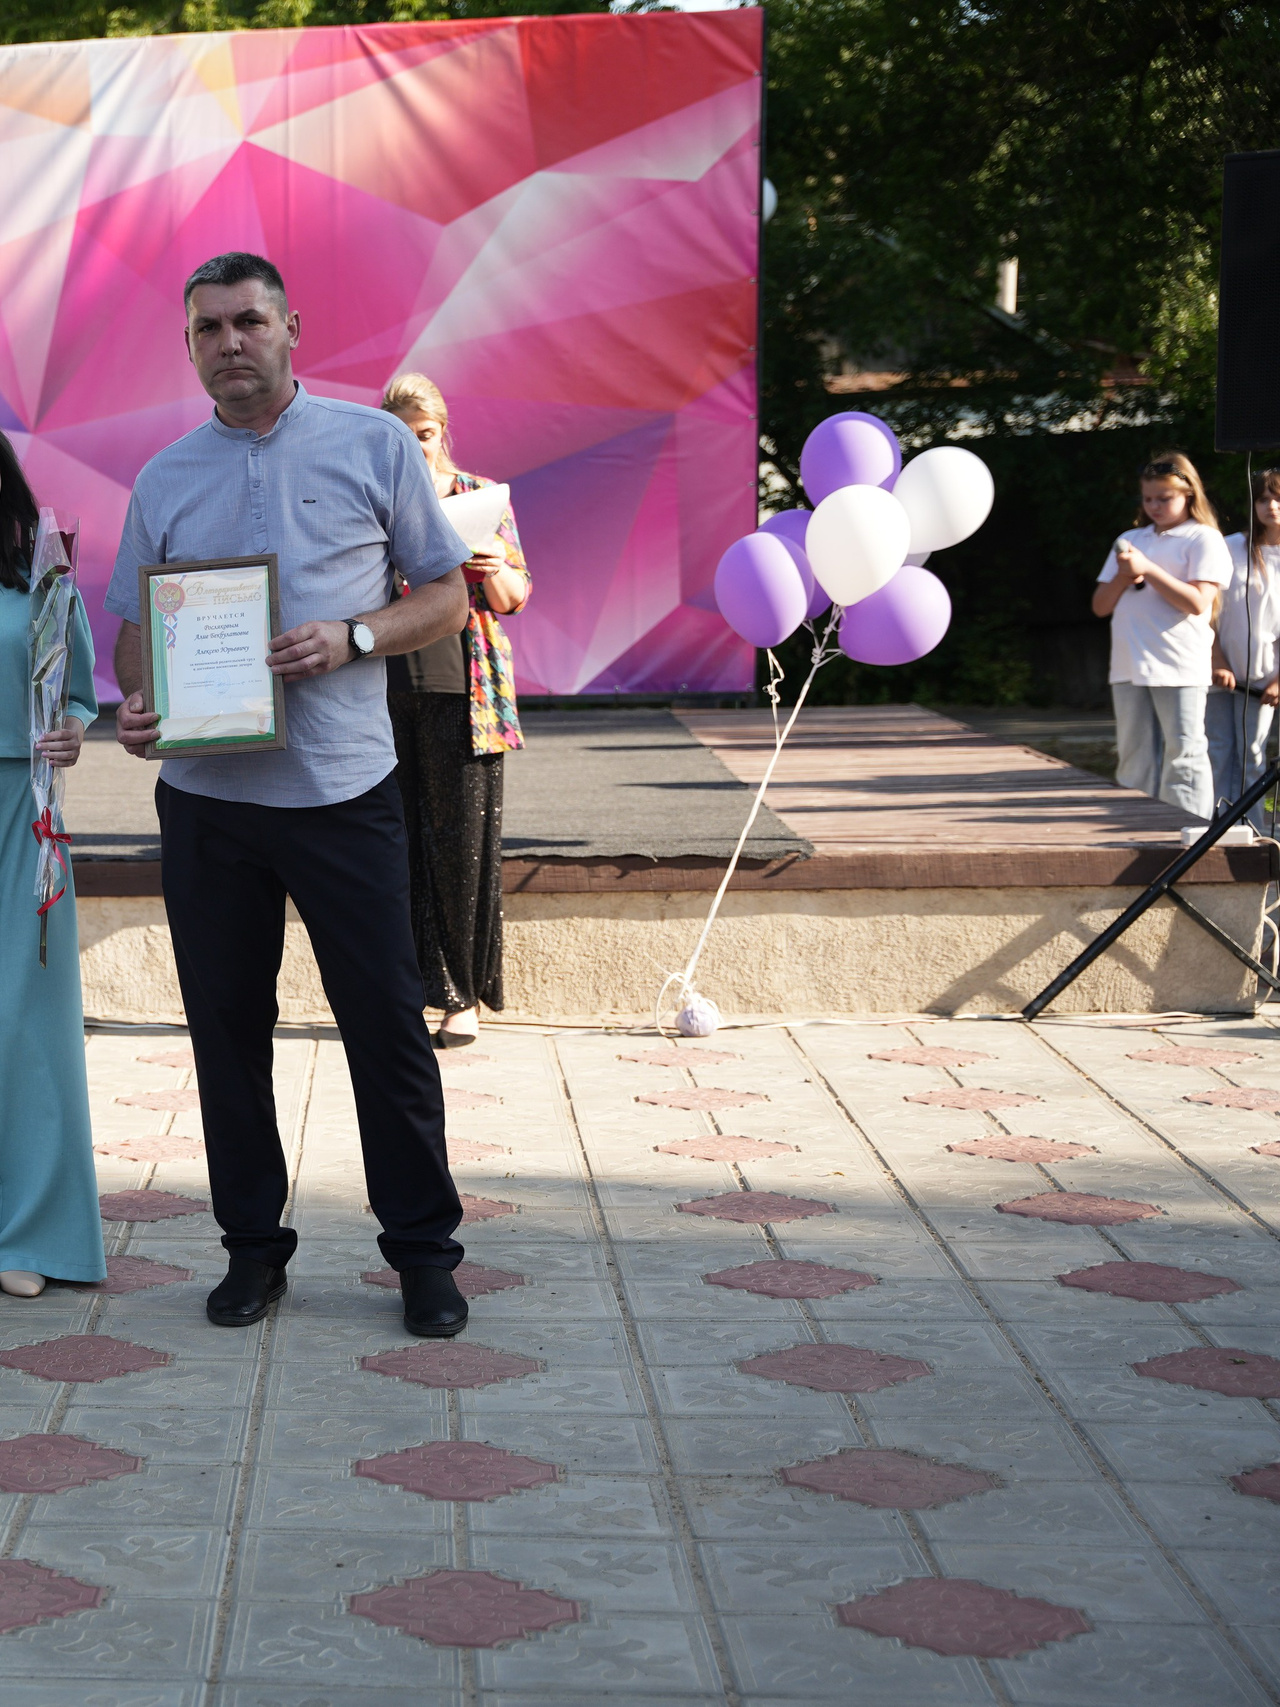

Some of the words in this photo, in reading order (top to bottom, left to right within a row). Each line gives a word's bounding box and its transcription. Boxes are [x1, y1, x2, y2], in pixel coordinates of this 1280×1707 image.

[213, 591, 262, 605] ПИСЬМО
[196, 612, 245, 622] ВРУЧАЕТСЯ
[204, 623, 239, 631] Росляковым
[194, 648, 220, 656] Алексею
[220, 646, 250, 654] Юрьевичу
